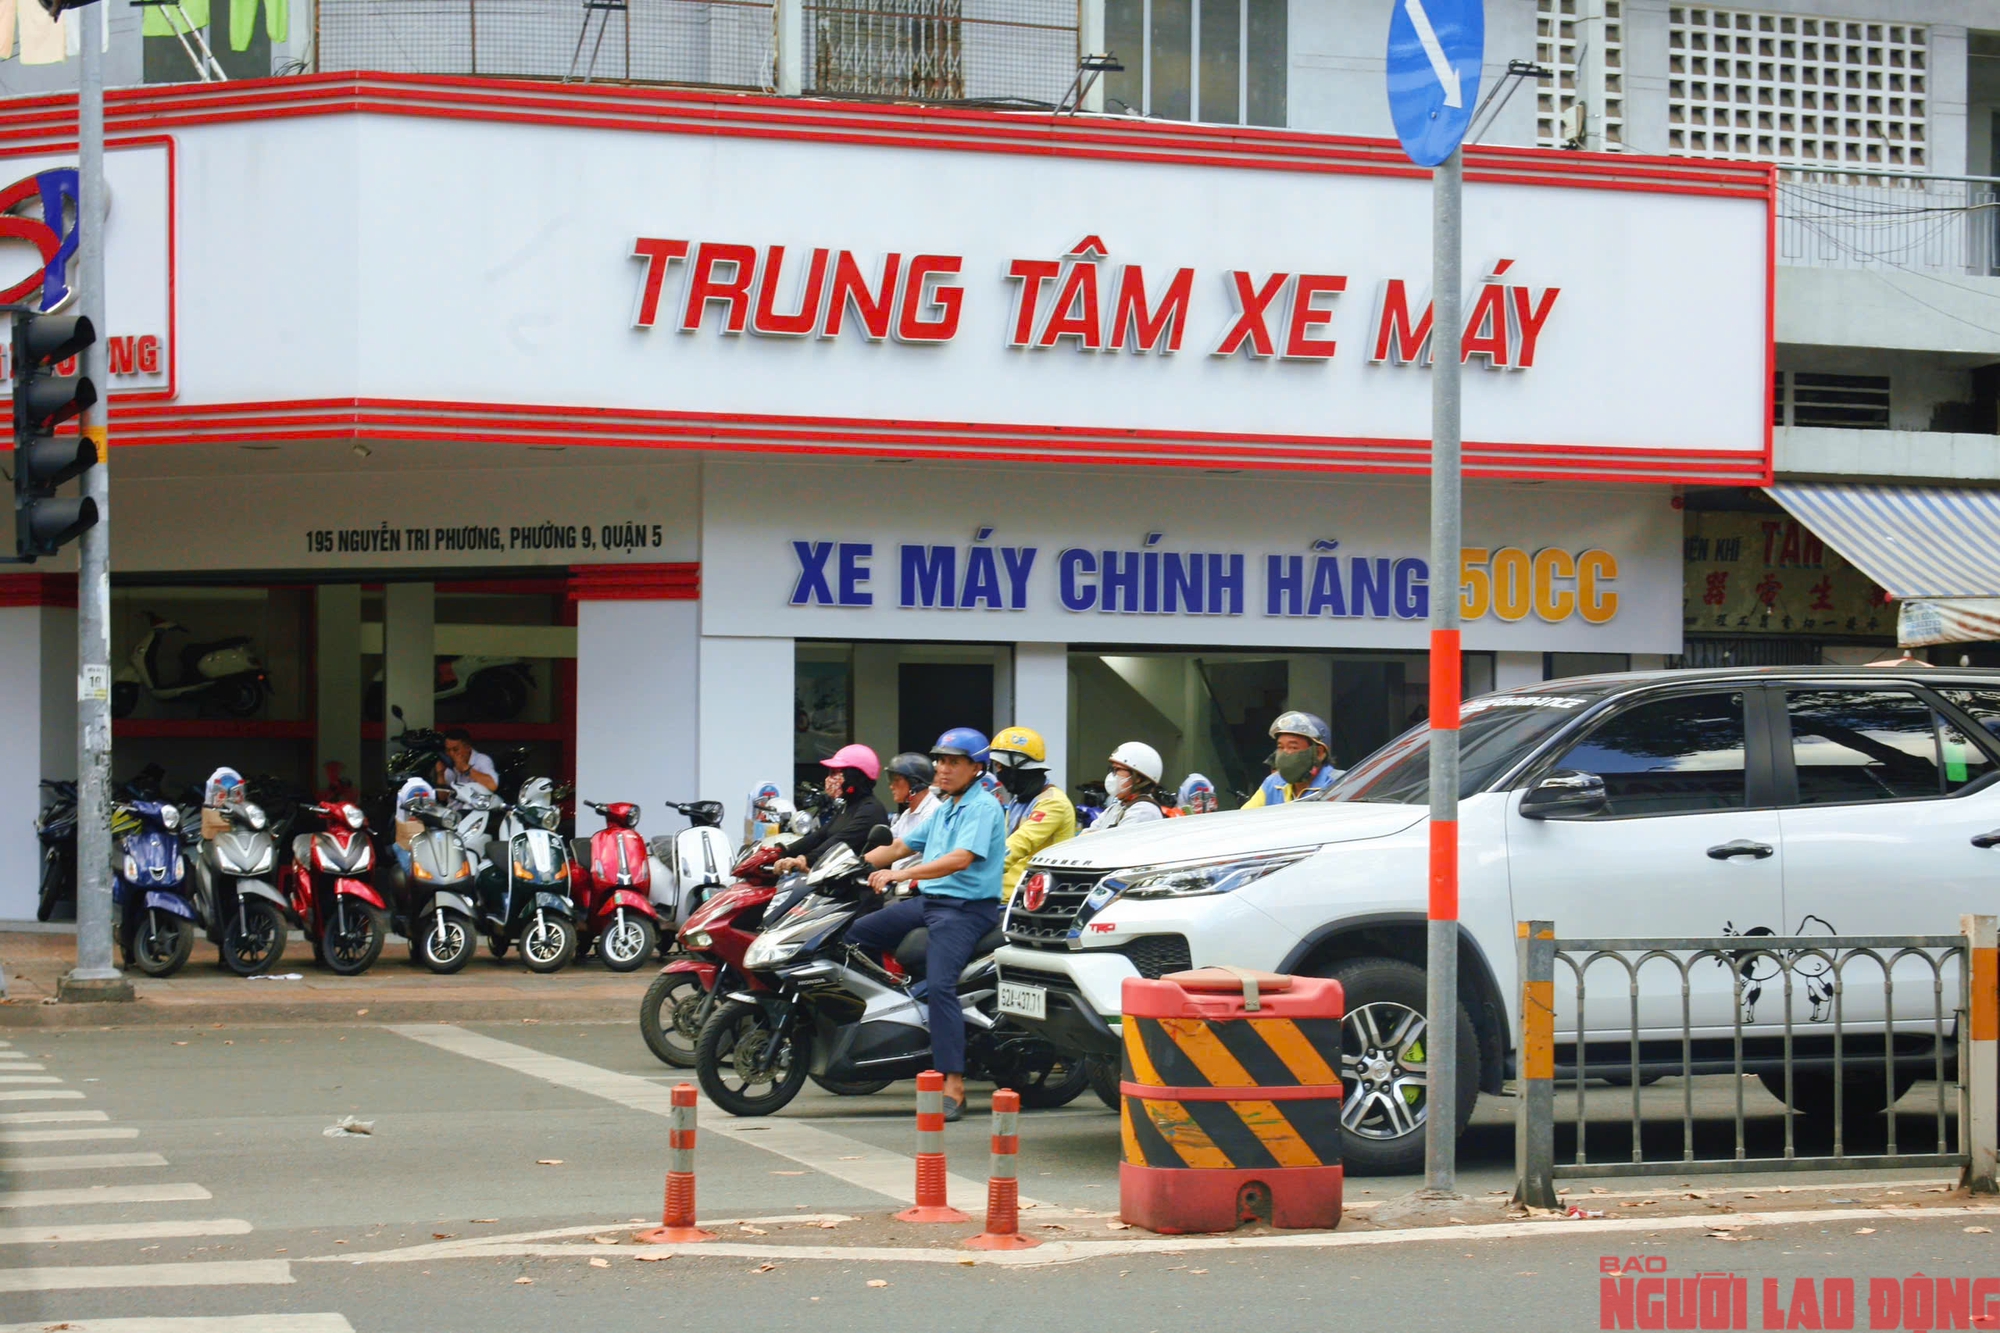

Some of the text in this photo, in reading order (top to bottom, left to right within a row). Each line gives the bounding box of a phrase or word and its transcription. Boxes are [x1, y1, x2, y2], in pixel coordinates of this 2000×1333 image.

[633, 234, 1562, 370] TRUNG TÂM XE MÁY
[305, 519, 663, 554] 195 NGUYỄN TRI PHƯƠNG, PHƯỜNG 9, QUẬN 5
[792, 528, 1618, 622] XE MÁY CHÍNH HÃNG 50CC
[1089, 923, 1116, 934] TRD
[797, 977, 827, 986] HONDA
